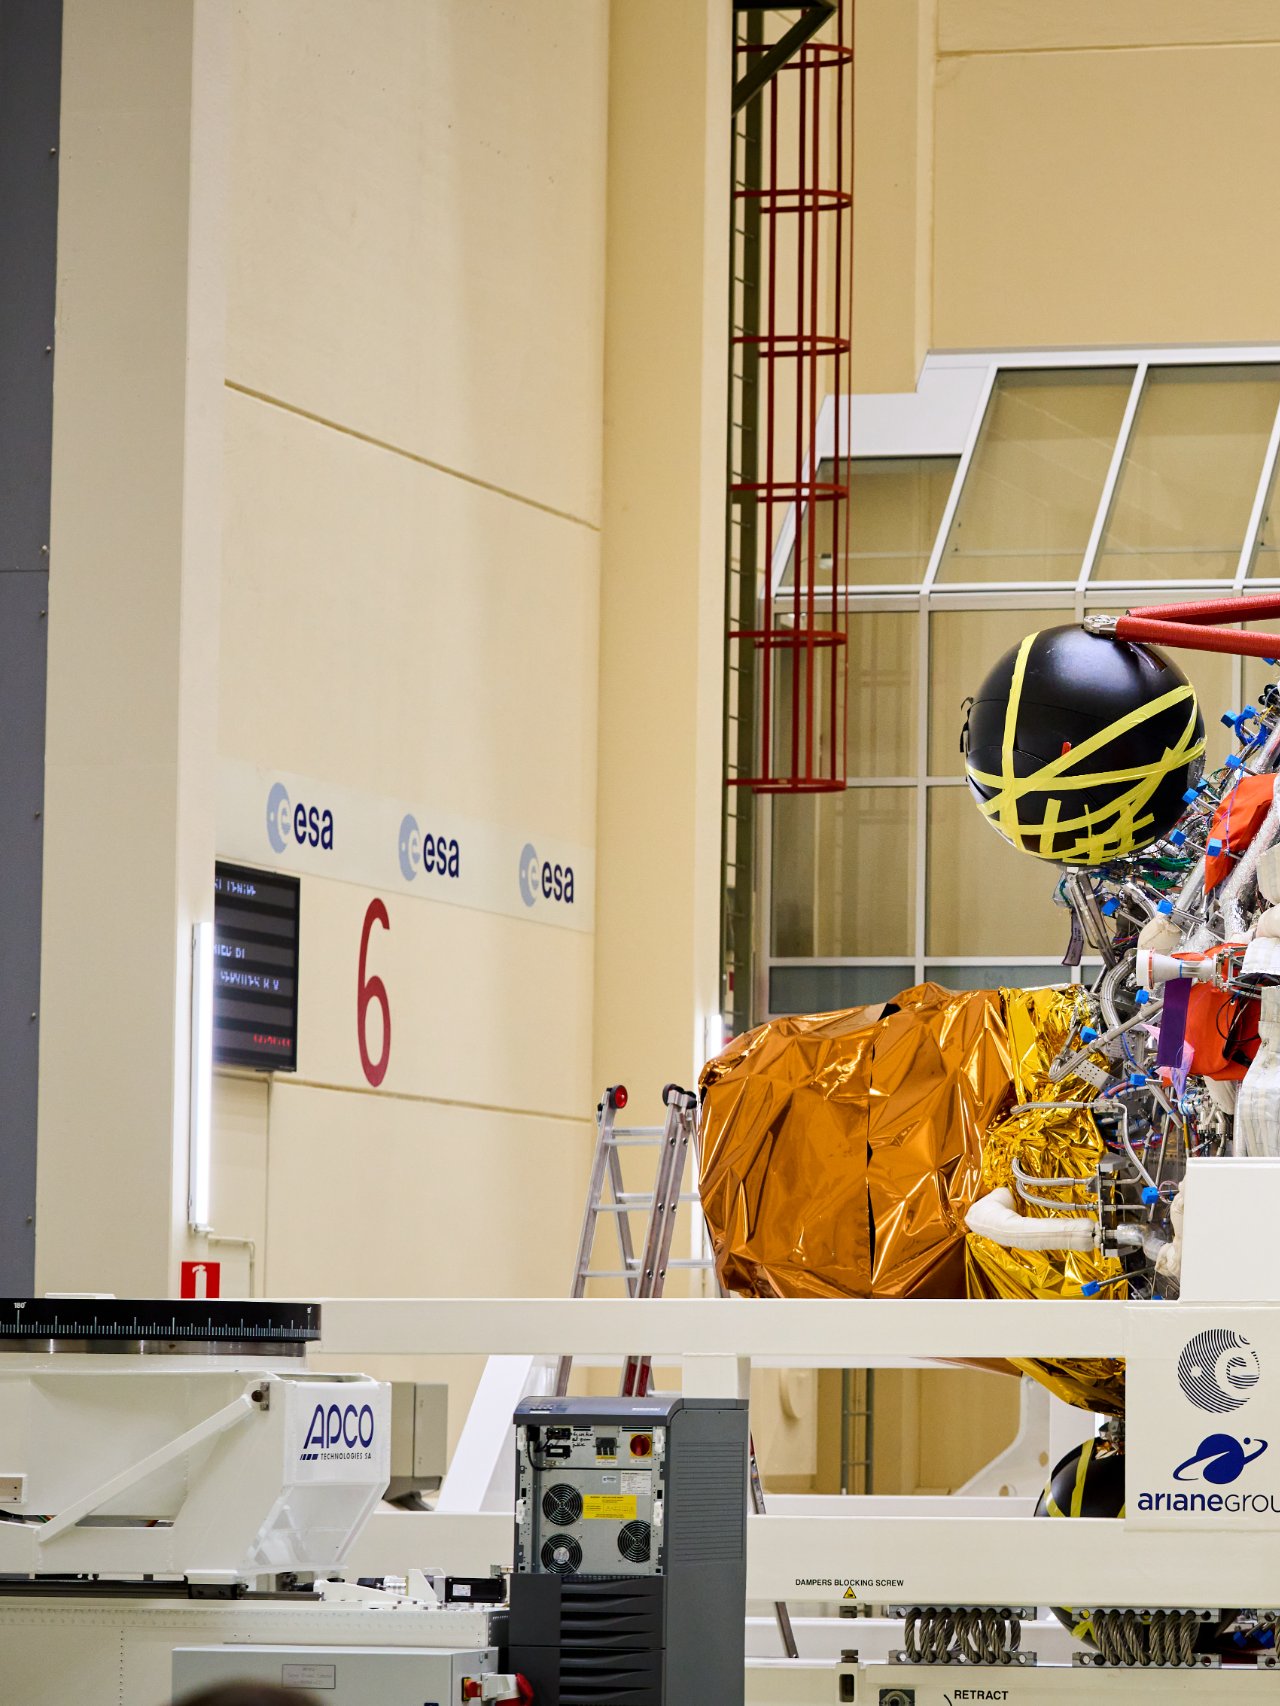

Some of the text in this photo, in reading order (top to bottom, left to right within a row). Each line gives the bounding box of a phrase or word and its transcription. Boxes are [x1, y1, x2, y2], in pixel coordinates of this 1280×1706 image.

[293, 803, 334, 850] esa
[423, 833, 460, 878] esa
[541, 860, 574, 904] esa
[357, 897, 392, 1088] 6
[303, 1403, 374, 1450] APCO
[834, 1579, 874, 1587] BLOCKING
[875, 1579, 905, 1587] SCREW
[953, 1689, 1009, 1700] RETRACT
